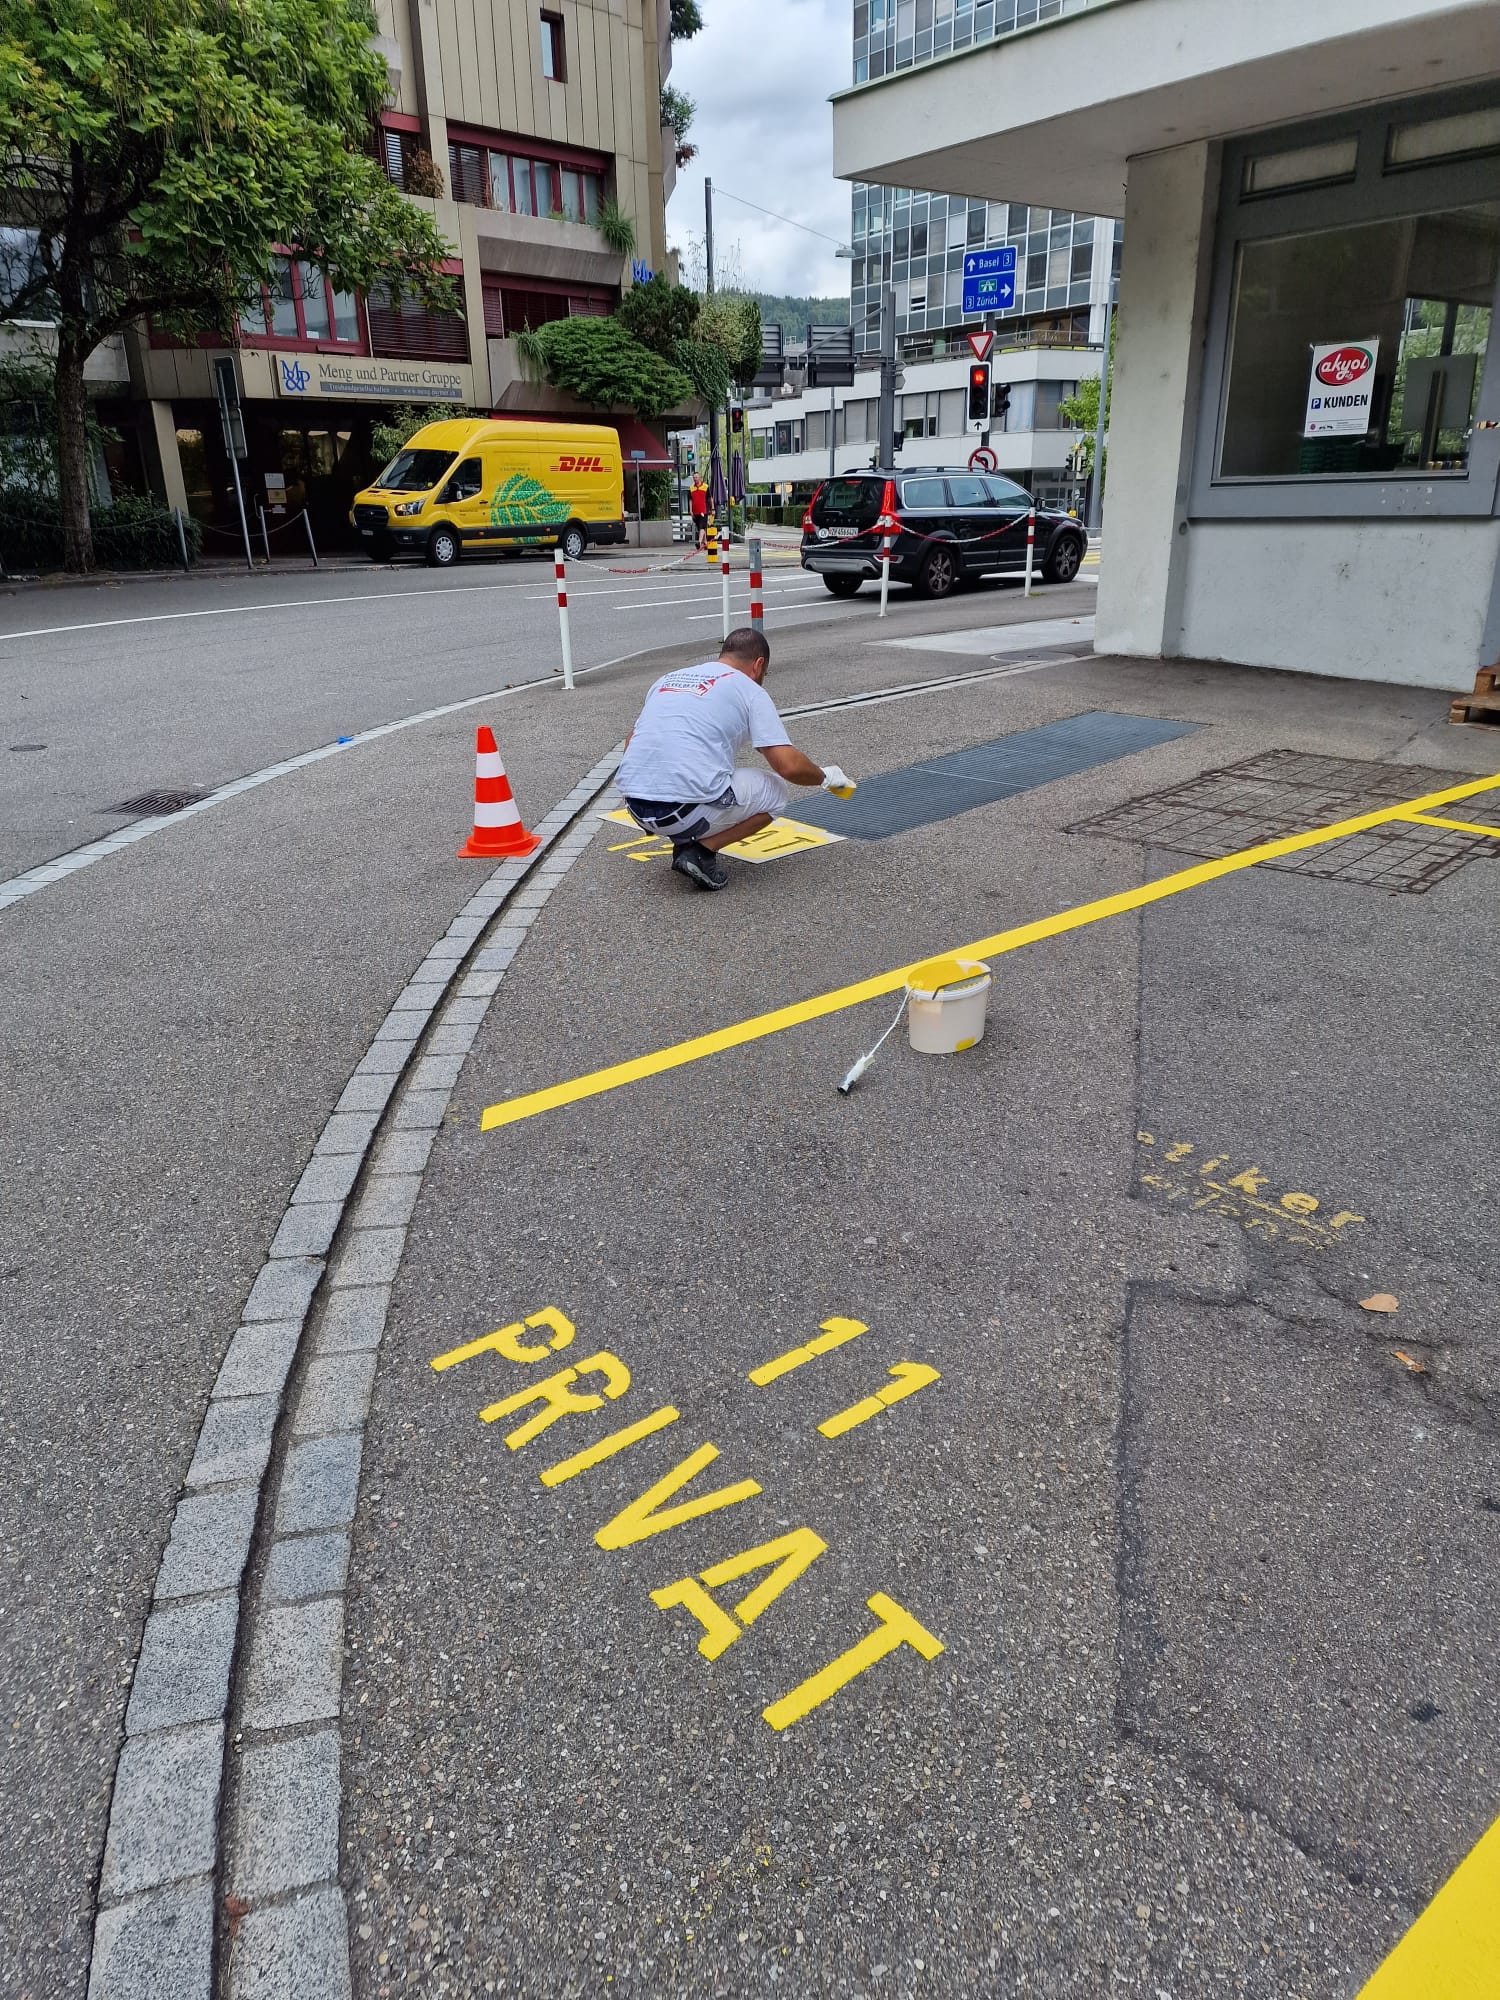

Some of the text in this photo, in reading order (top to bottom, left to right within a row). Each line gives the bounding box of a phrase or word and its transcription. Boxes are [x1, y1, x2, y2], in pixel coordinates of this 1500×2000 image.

[979, 256, 1000, 269] Basel
[976, 294, 998, 307] Zürich
[281, 360, 310, 392] M&P
[319, 363, 461, 389] Meng und Partner Gruppe
[1321, 353, 1367, 381] akyol
[1324, 394, 1368, 409] KUNDEN
[559, 456, 604, 473] DHL
[749, 1317, 941, 1439] 11
[430, 1306, 945, 1732] PRIVAT
